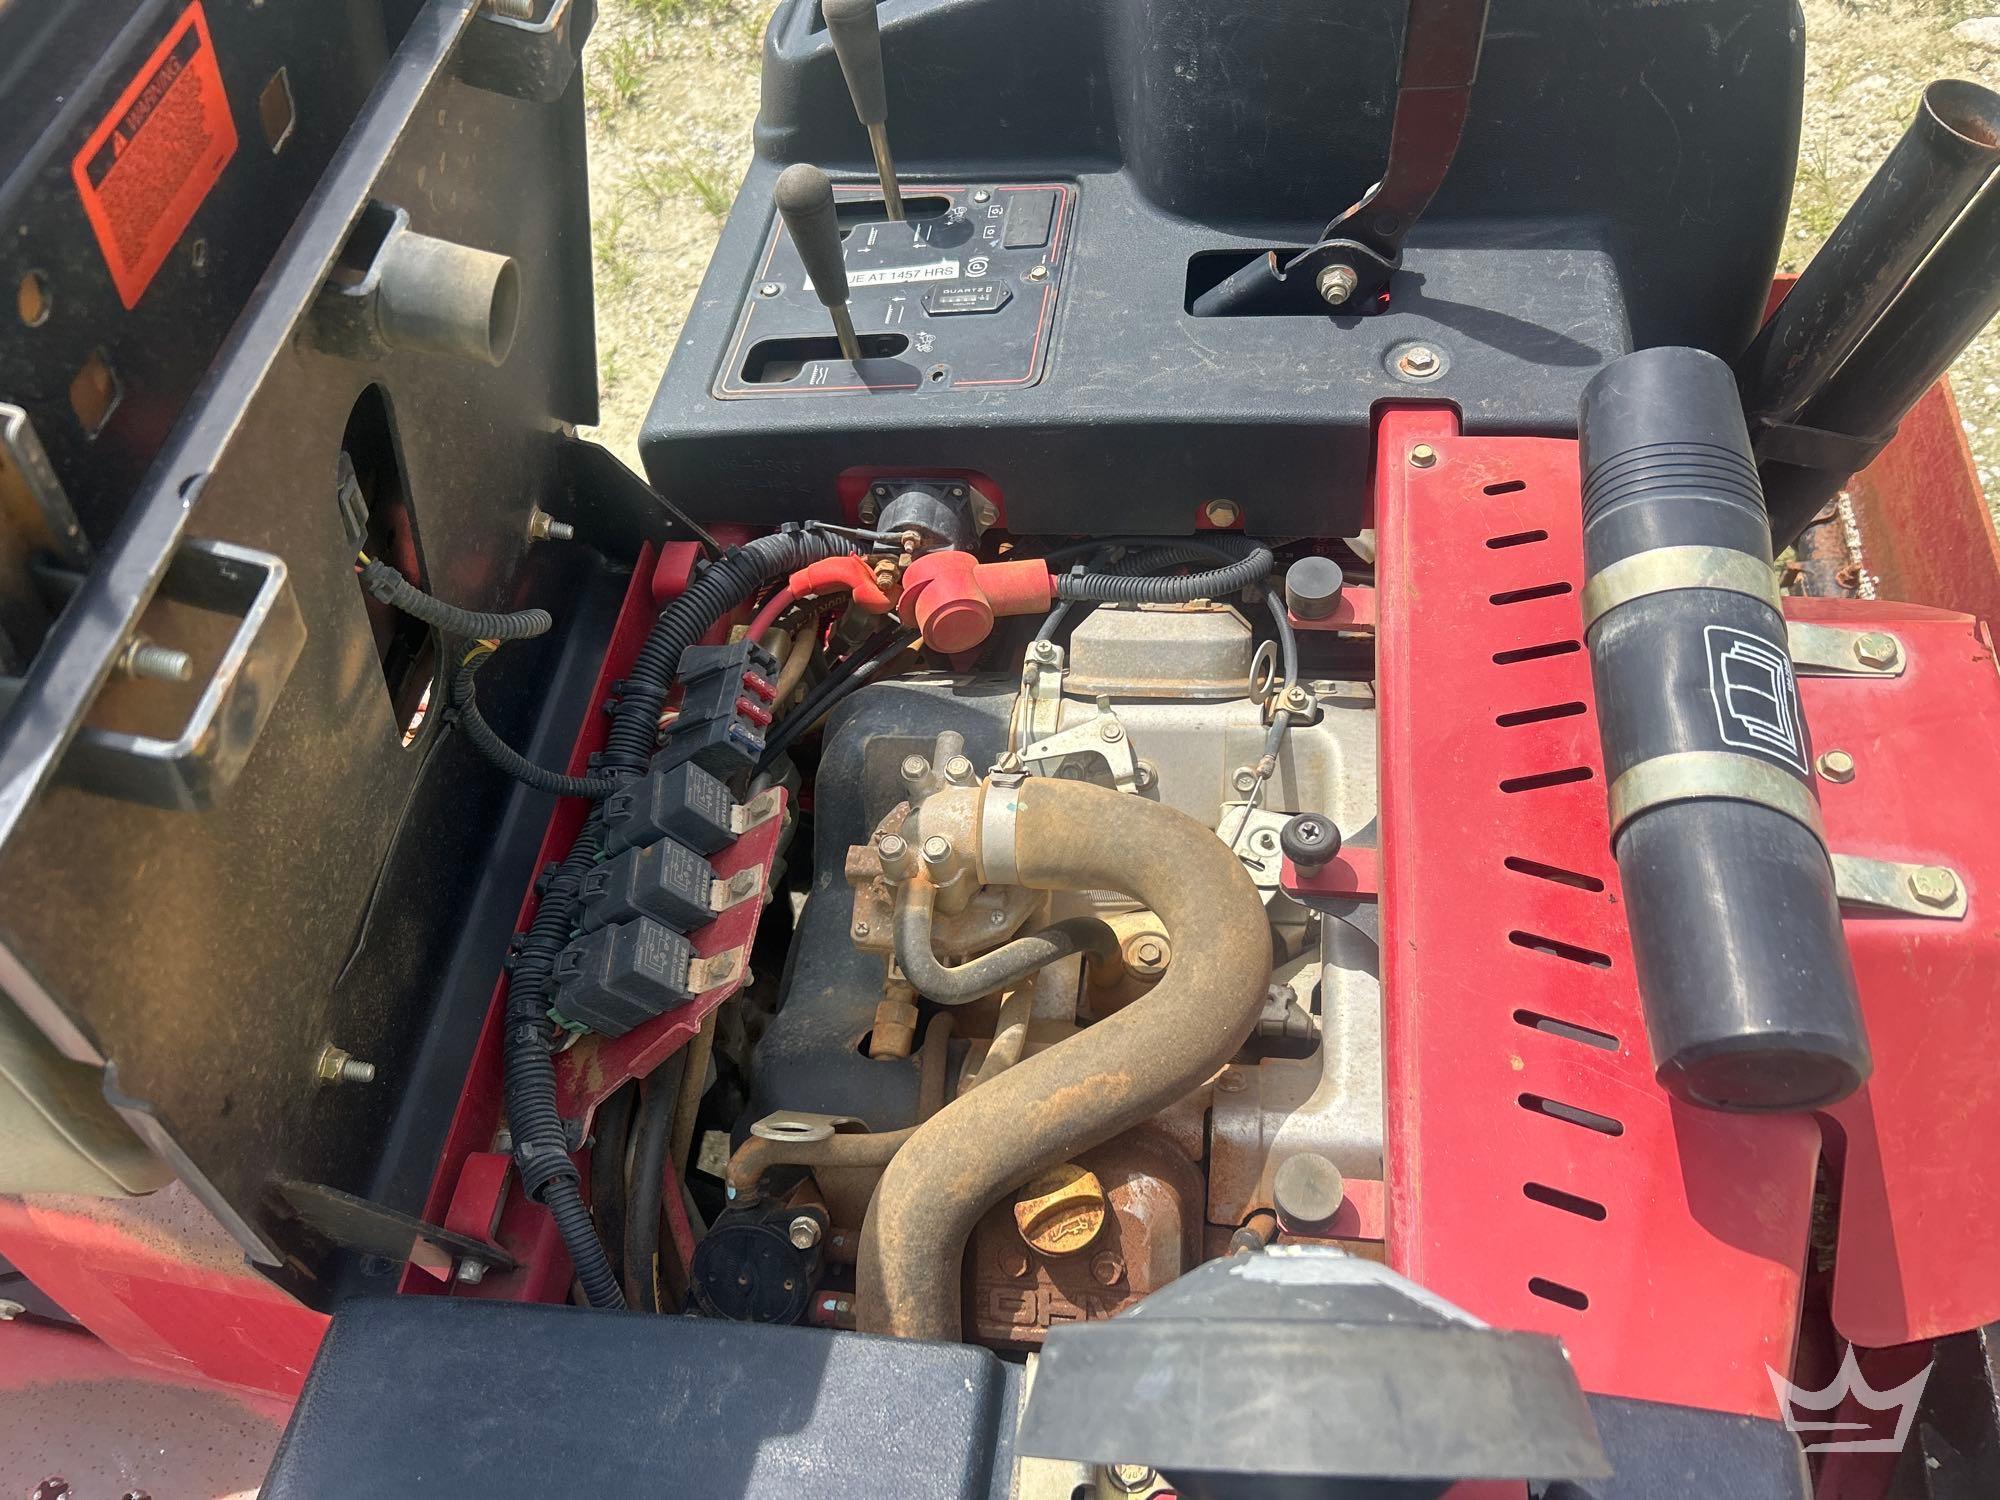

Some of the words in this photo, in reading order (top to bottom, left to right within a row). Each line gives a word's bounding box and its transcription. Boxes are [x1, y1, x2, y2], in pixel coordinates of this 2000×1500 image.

[868, 272, 887, 282] AT
[892, 269, 921, 280] 1457
[924, 266, 953, 277] HRS
